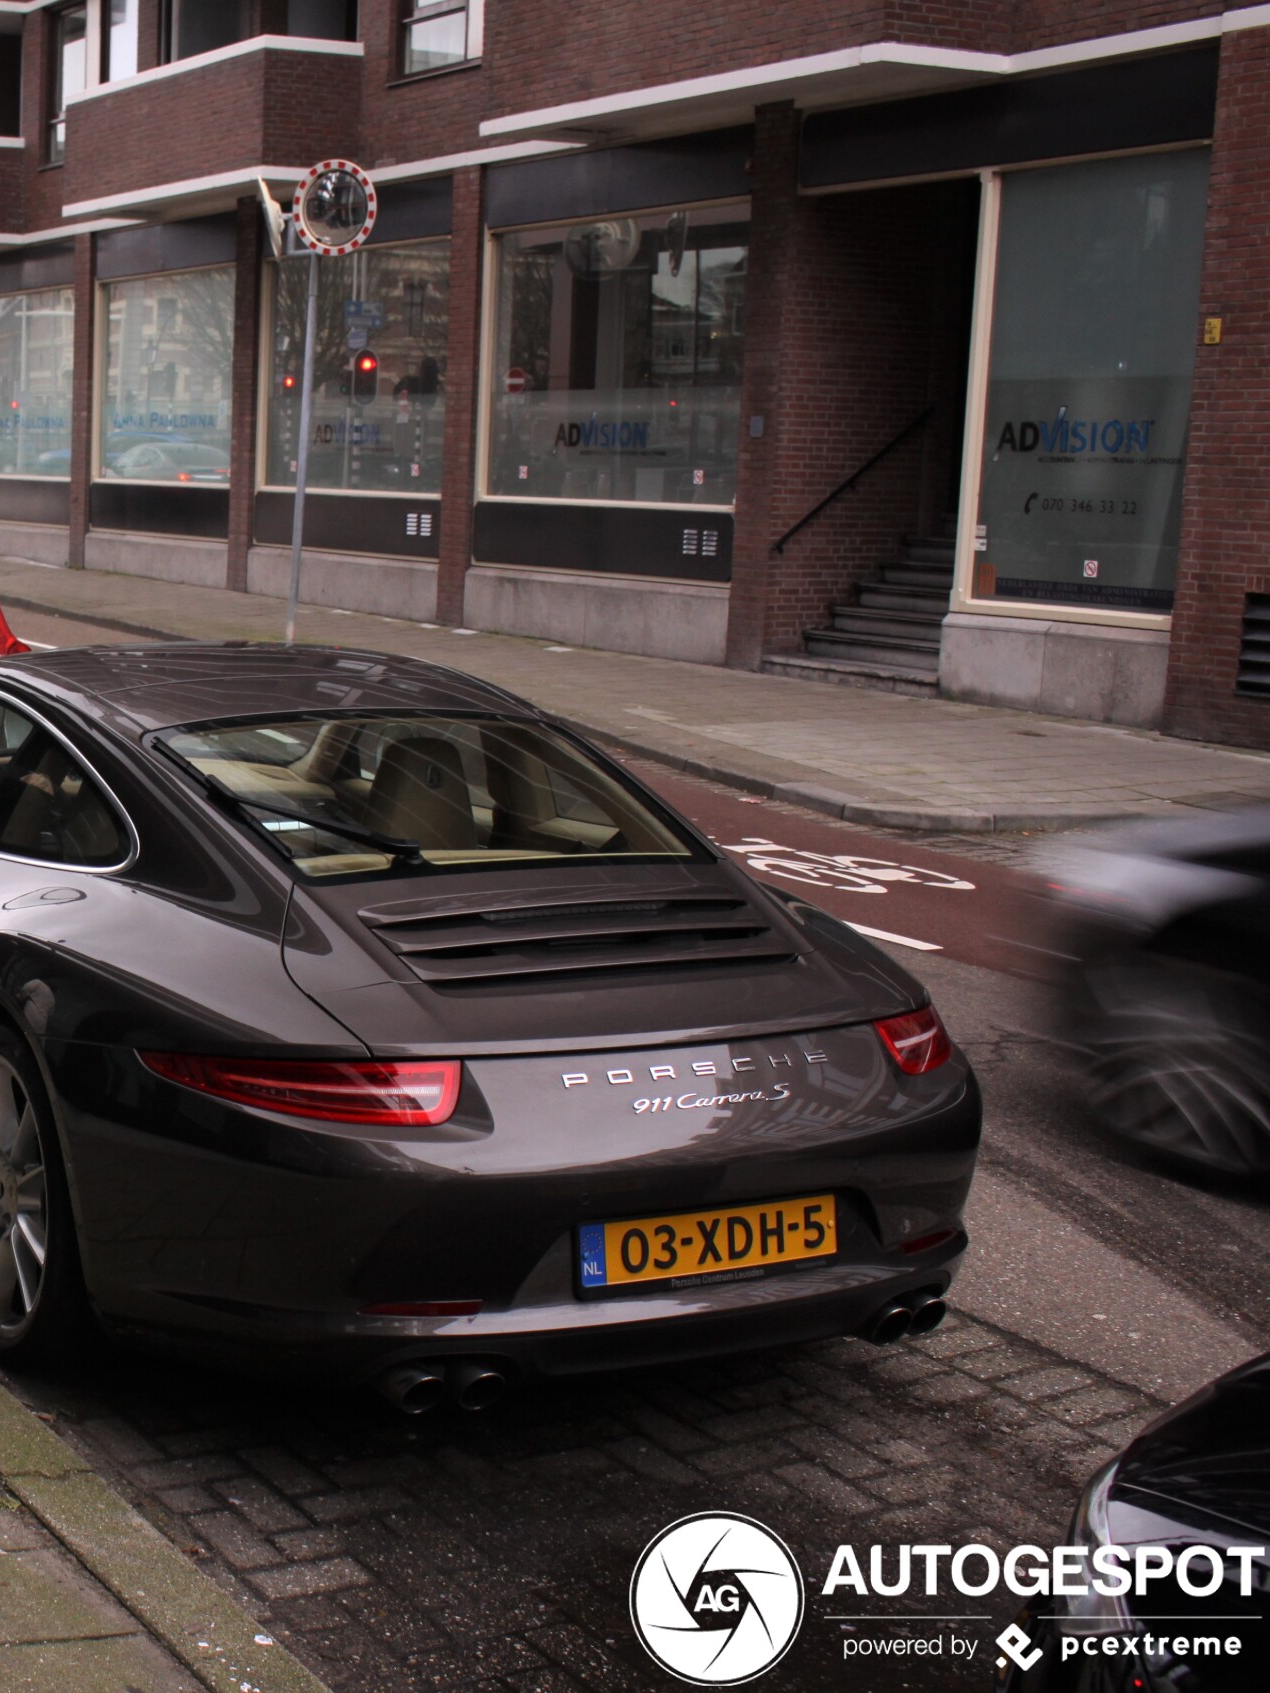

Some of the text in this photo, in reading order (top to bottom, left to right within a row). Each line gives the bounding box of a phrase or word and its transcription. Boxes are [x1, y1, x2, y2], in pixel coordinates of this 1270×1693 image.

[551, 411, 649, 455] ADVISION
[993, 405, 1152, 461] ADVISION
[1042, 498, 1137, 515] 070 346 33 22
[561, 1049, 828, 1088] PORSCHE
[632, 1083, 791, 1115] 911 Carrera S
[620, 1204, 826, 1274] 03-XDH-5
[583, 1262, 603, 1276] NL
[671, 1277, 701, 1288] Porsche
[702, 1273, 734, 1284] Centrum
